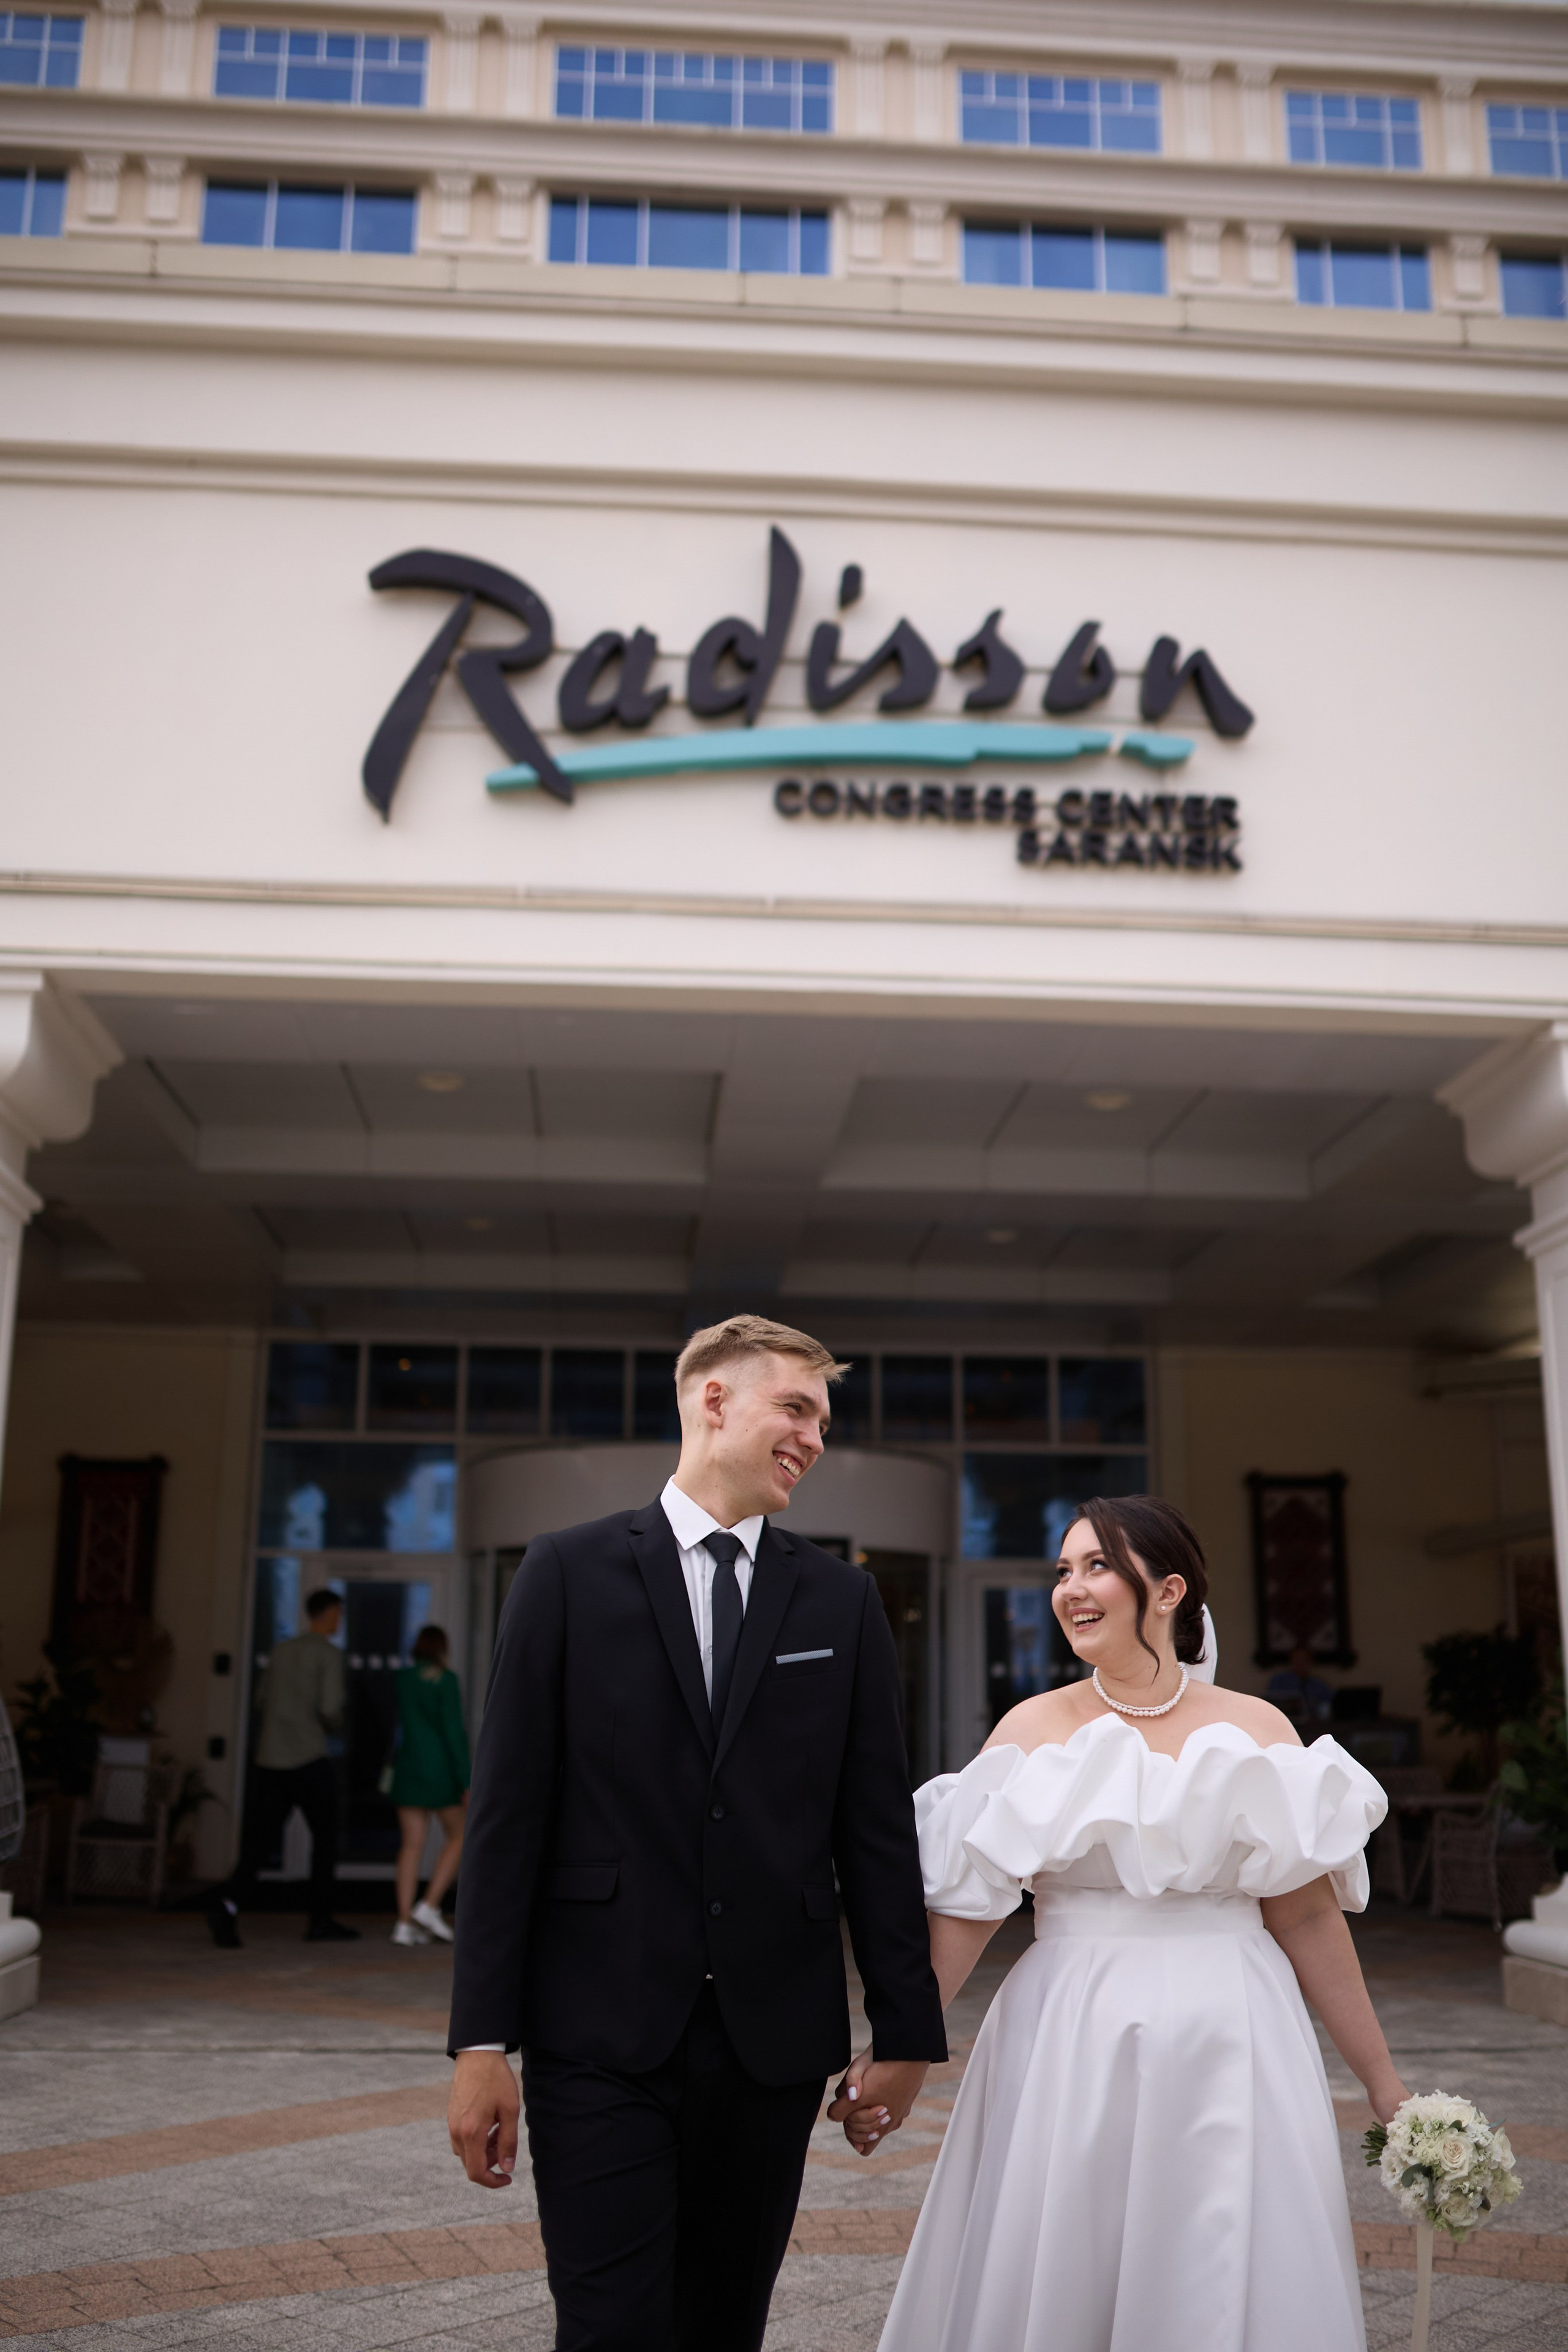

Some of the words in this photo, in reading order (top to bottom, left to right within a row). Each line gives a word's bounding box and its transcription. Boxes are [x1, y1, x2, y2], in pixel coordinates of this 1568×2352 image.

[363, 524, 1256, 823] Radisson
[774, 779, 1036, 823] CONGRESS
[1055, 789, 1240, 832] CENTER
[1016, 829, 1244, 872] SARANSK
